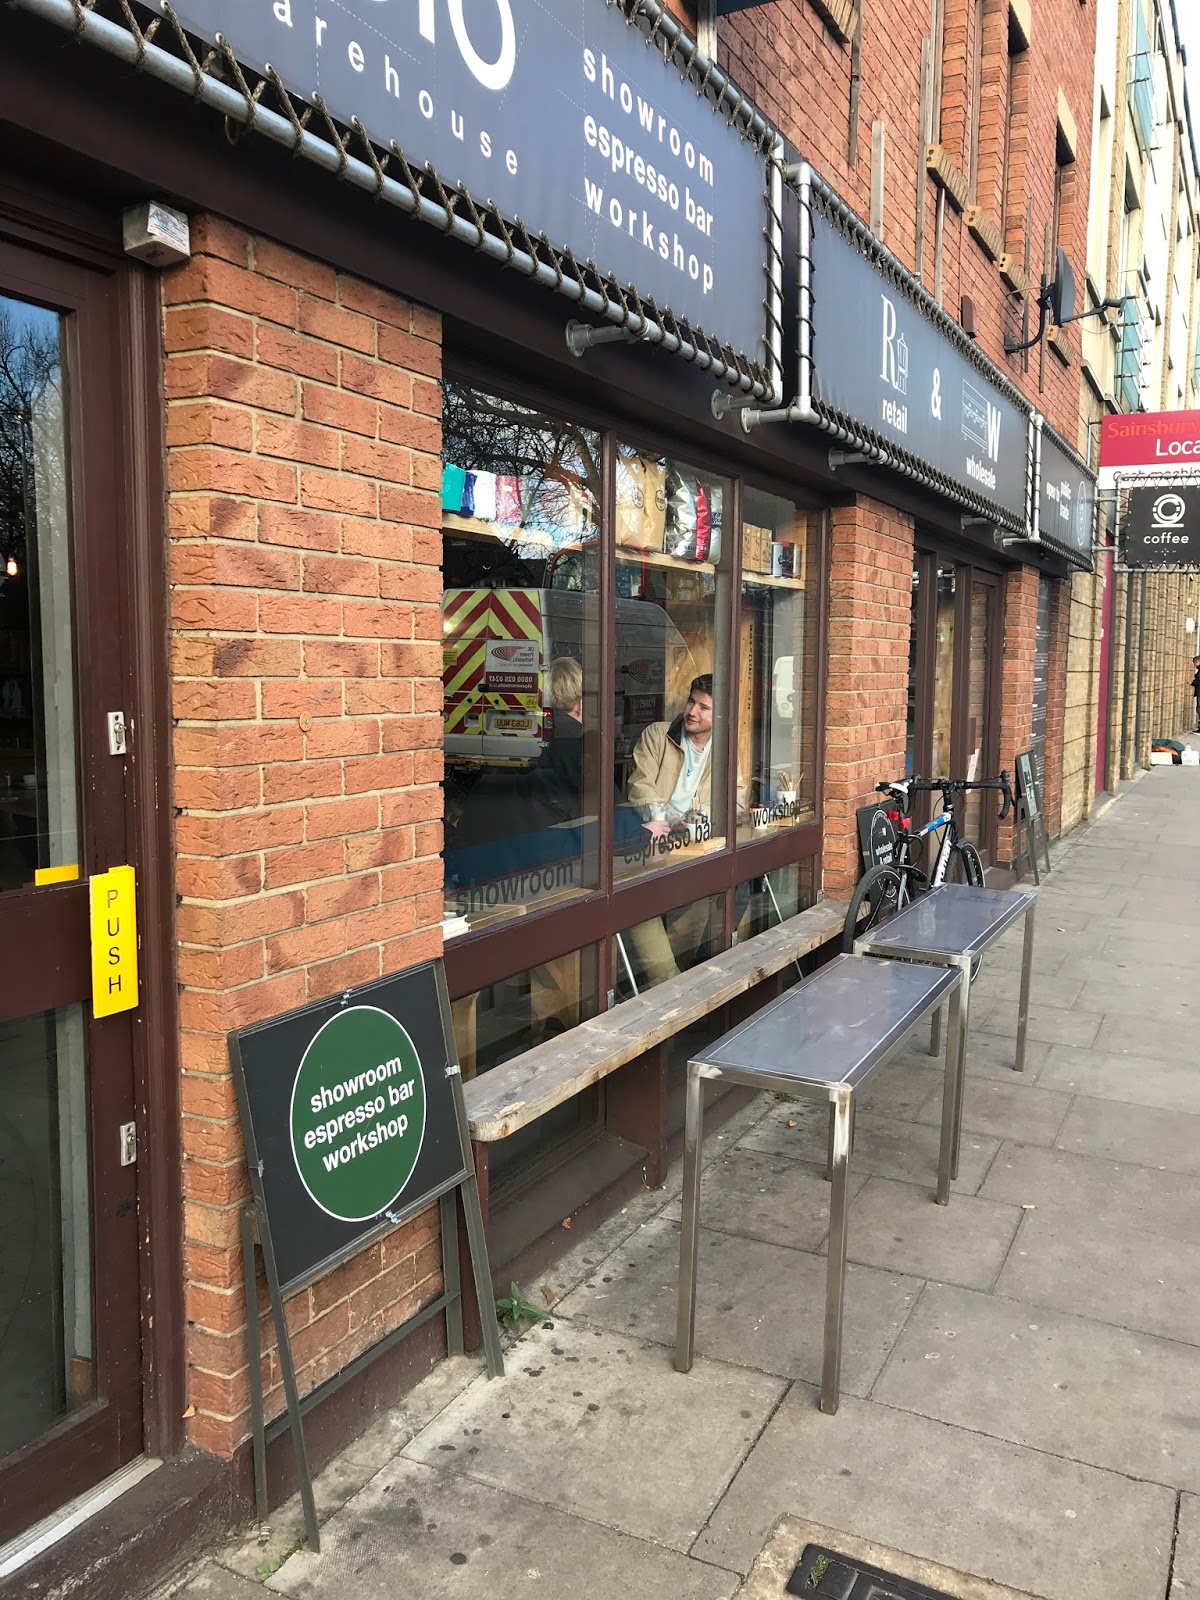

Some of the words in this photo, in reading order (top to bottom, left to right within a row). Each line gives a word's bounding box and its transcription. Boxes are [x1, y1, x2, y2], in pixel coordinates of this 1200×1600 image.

[583, 47, 714, 187] showroom
[583, 114, 680, 212] espresso
[685, 186, 713, 237] bar
[584, 176, 714, 295] workshop
[879, 293, 899, 390] R
[931, 367, 942, 420] &
[986, 401, 1001, 462] W
[882, 398, 908, 434] retail
[966, 455, 996, 491] wholesale
[1143, 531, 1190, 544] coffee
[622, 826, 691, 866] espresso
[694, 815, 714, 843] bar
[454, 859, 574, 917] showroom
[107, 889, 122, 995] PUSH
[304, 1095, 385, 1149] espresso
[388, 1079, 415, 1107] bar
[310, 1056, 402, 1113] showroom
[322, 1114, 409, 1172] workshop
